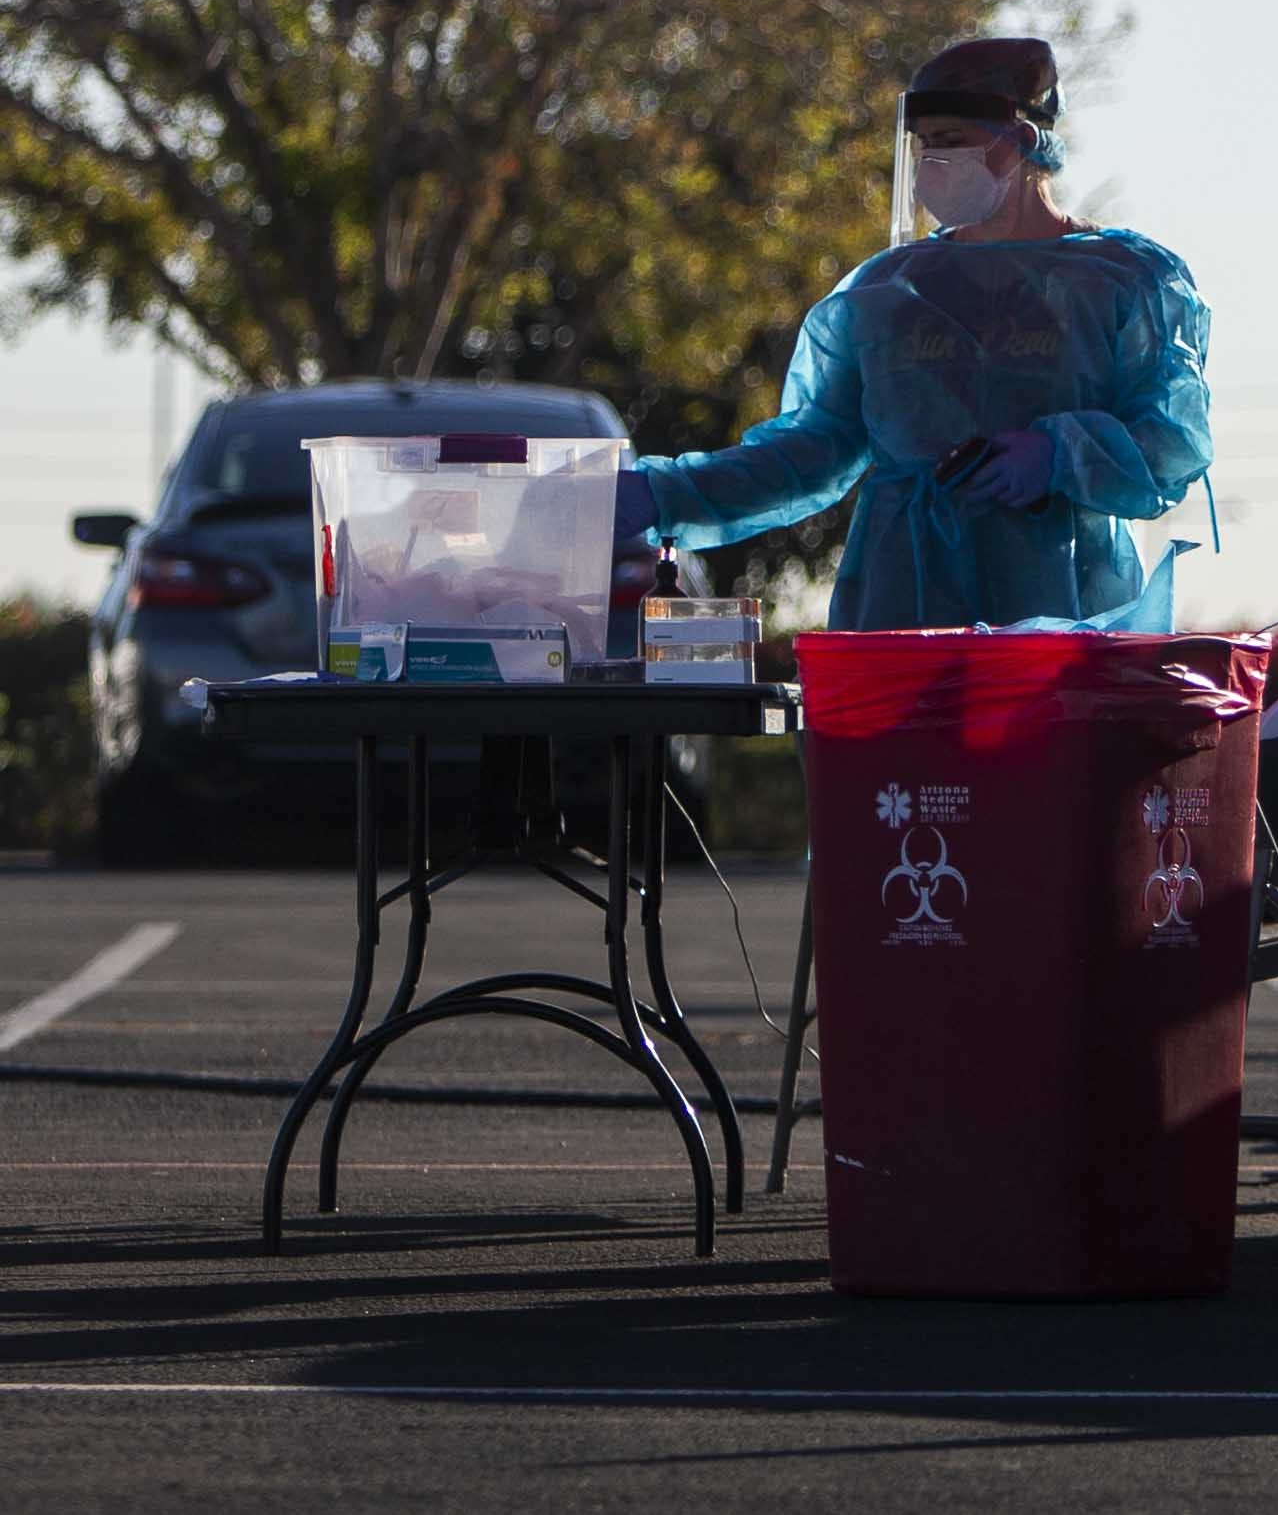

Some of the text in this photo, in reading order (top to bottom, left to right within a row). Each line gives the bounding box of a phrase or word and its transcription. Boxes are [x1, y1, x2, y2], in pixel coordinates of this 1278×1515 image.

[919, 785, 969, 794] Arizona
[919, 794, 969, 804] Medical
[919, 804, 957, 814] Waste
